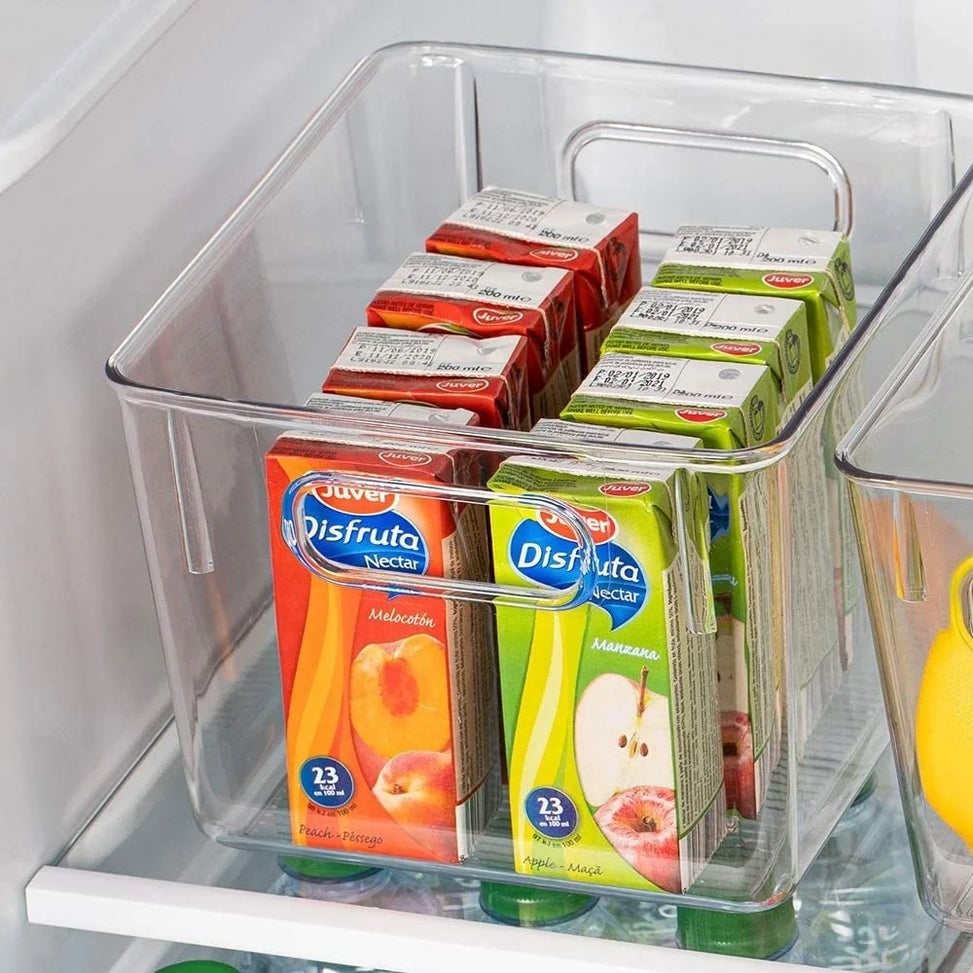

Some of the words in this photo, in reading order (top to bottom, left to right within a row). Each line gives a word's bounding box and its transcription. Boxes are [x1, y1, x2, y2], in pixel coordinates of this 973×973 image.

[766, 275, 811, 284] Juver
[477, 312, 520, 322] Juver
[714, 345, 760, 353] Juver
[440, 381, 484, 389] Juver
[679, 410, 725, 418] Juver
[384, 452, 427, 462] Juver
[319, 486, 392, 503] Juver
[602, 483, 647, 492] Juver
[545, 514, 609, 534] Jer
[364, 555, 420, 571] Nectar
[517, 542, 640, 583] Disfuta
[368, 607, 437, 628] Melocotón
[591, 637, 661, 661] Manzana
[312, 766, 339, 784] 23
[319, 783, 336, 791] kcal
[536, 796, 564, 815] 23
[544, 814, 562, 822] kcal
[299, 824, 334, 839] Peach
[522, 855, 557, 872] Apple
